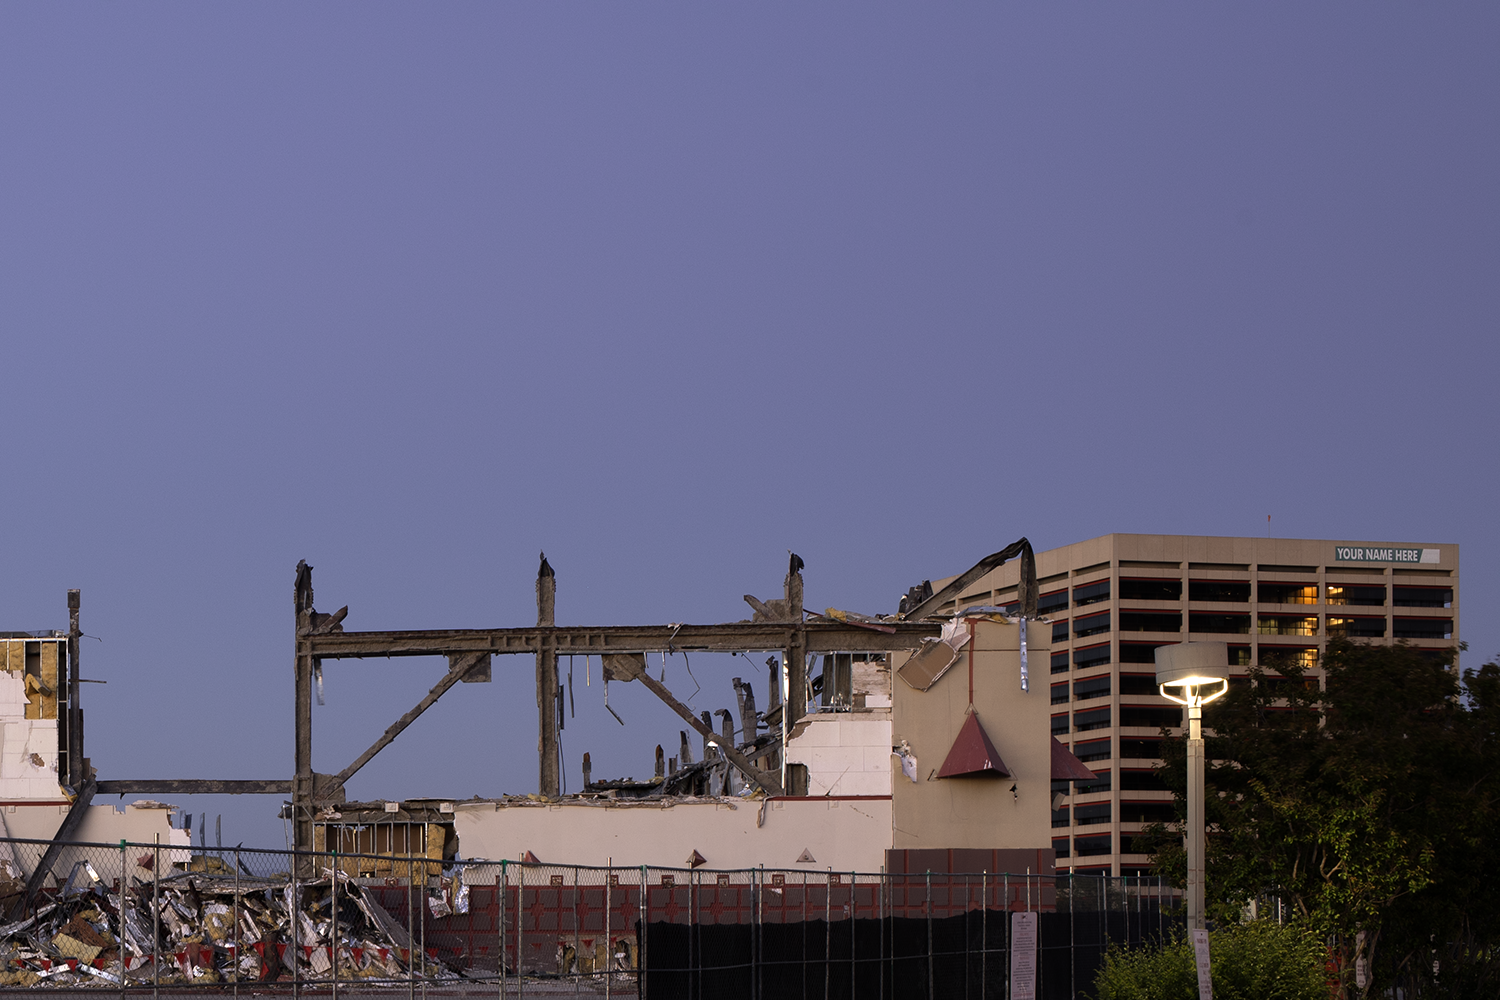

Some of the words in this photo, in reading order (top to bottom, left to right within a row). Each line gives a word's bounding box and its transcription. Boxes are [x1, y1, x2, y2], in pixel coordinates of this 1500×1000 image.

[1337, 548, 1363, 560] YOUR
[1365, 549, 1393, 561] NAME
[1395, 550, 1418, 562] HERE
